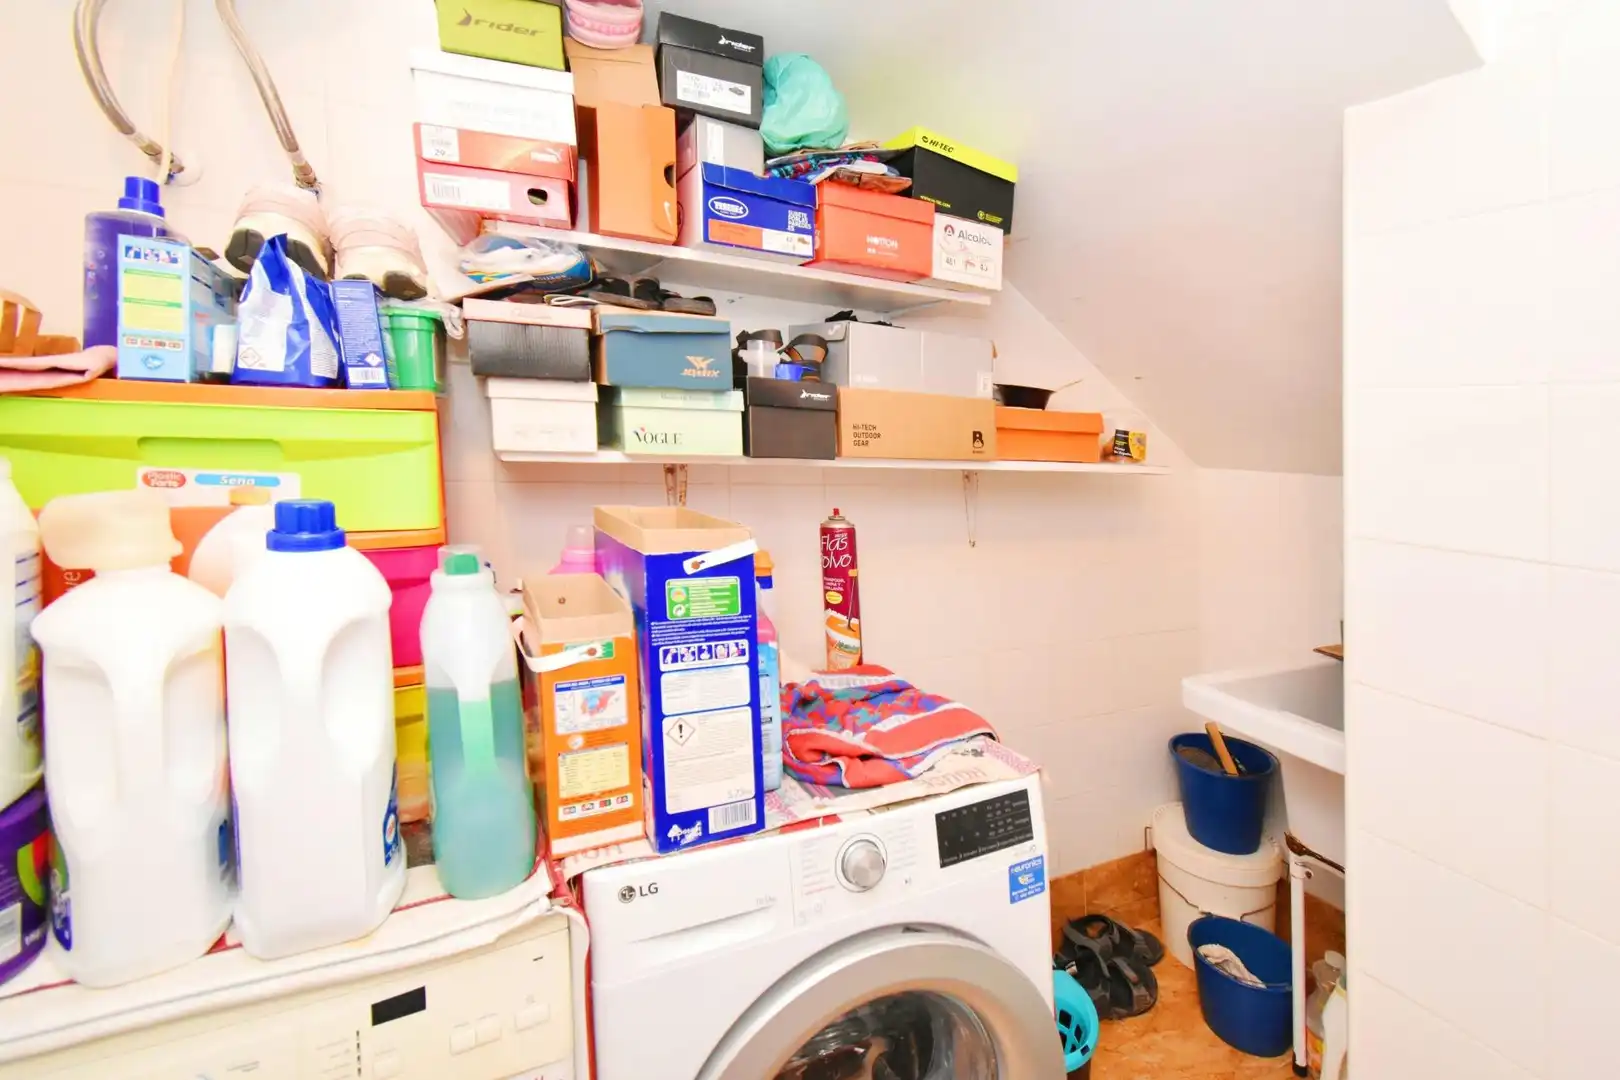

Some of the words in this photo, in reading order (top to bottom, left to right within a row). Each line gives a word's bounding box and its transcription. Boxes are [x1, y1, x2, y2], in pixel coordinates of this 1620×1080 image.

[474, 19, 546, 36] rider
[928, 139, 955, 153] HI-TEC
[633, 427, 684, 444] VOGUE
[639, 882, 659, 897] LG
